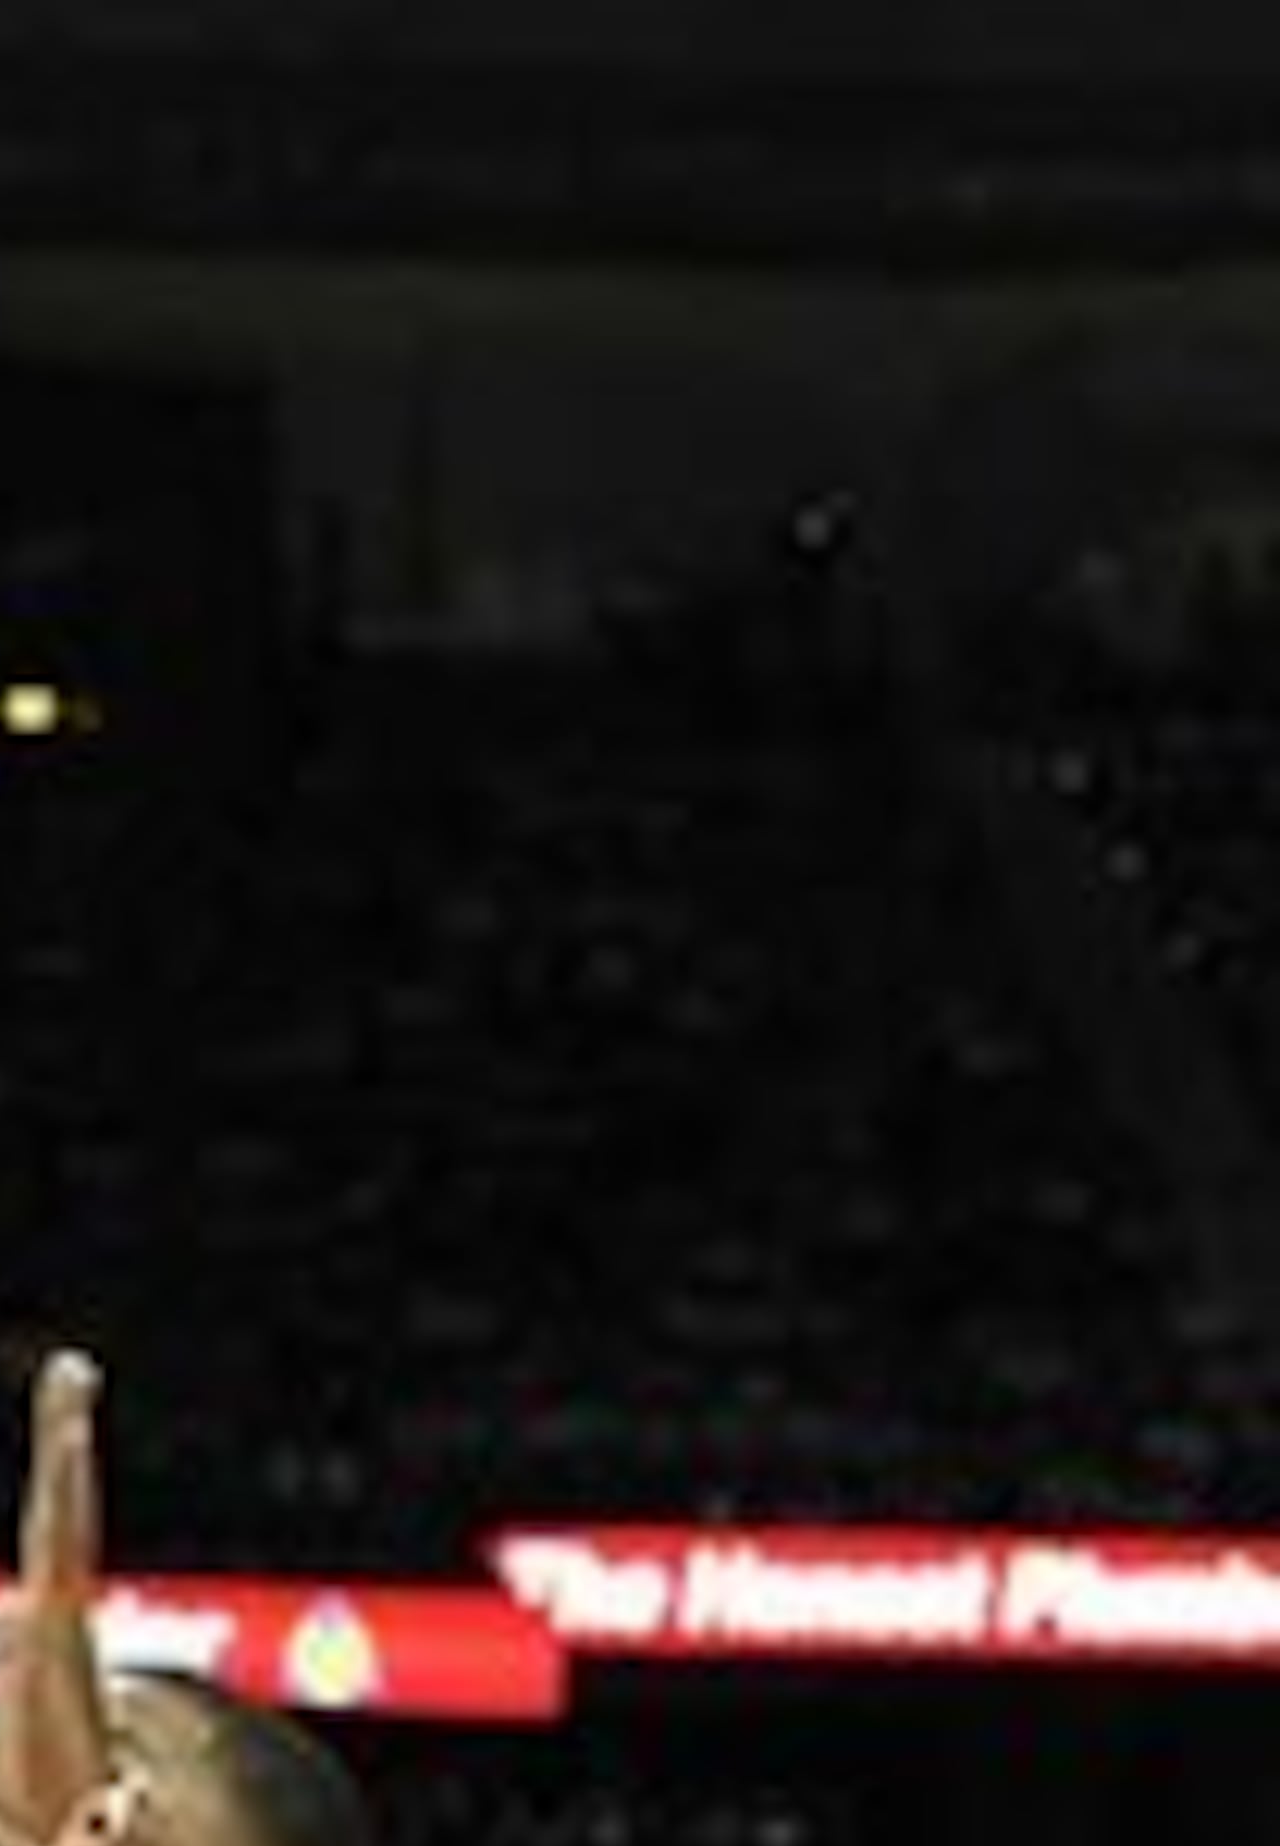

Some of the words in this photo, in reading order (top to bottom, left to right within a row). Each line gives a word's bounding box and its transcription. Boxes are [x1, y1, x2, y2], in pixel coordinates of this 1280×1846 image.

[490, 1533, 670, 1634] The
[680, 1545, 990, 1642] Honest
[1000, 1548, 1280, 1648] Plumb
